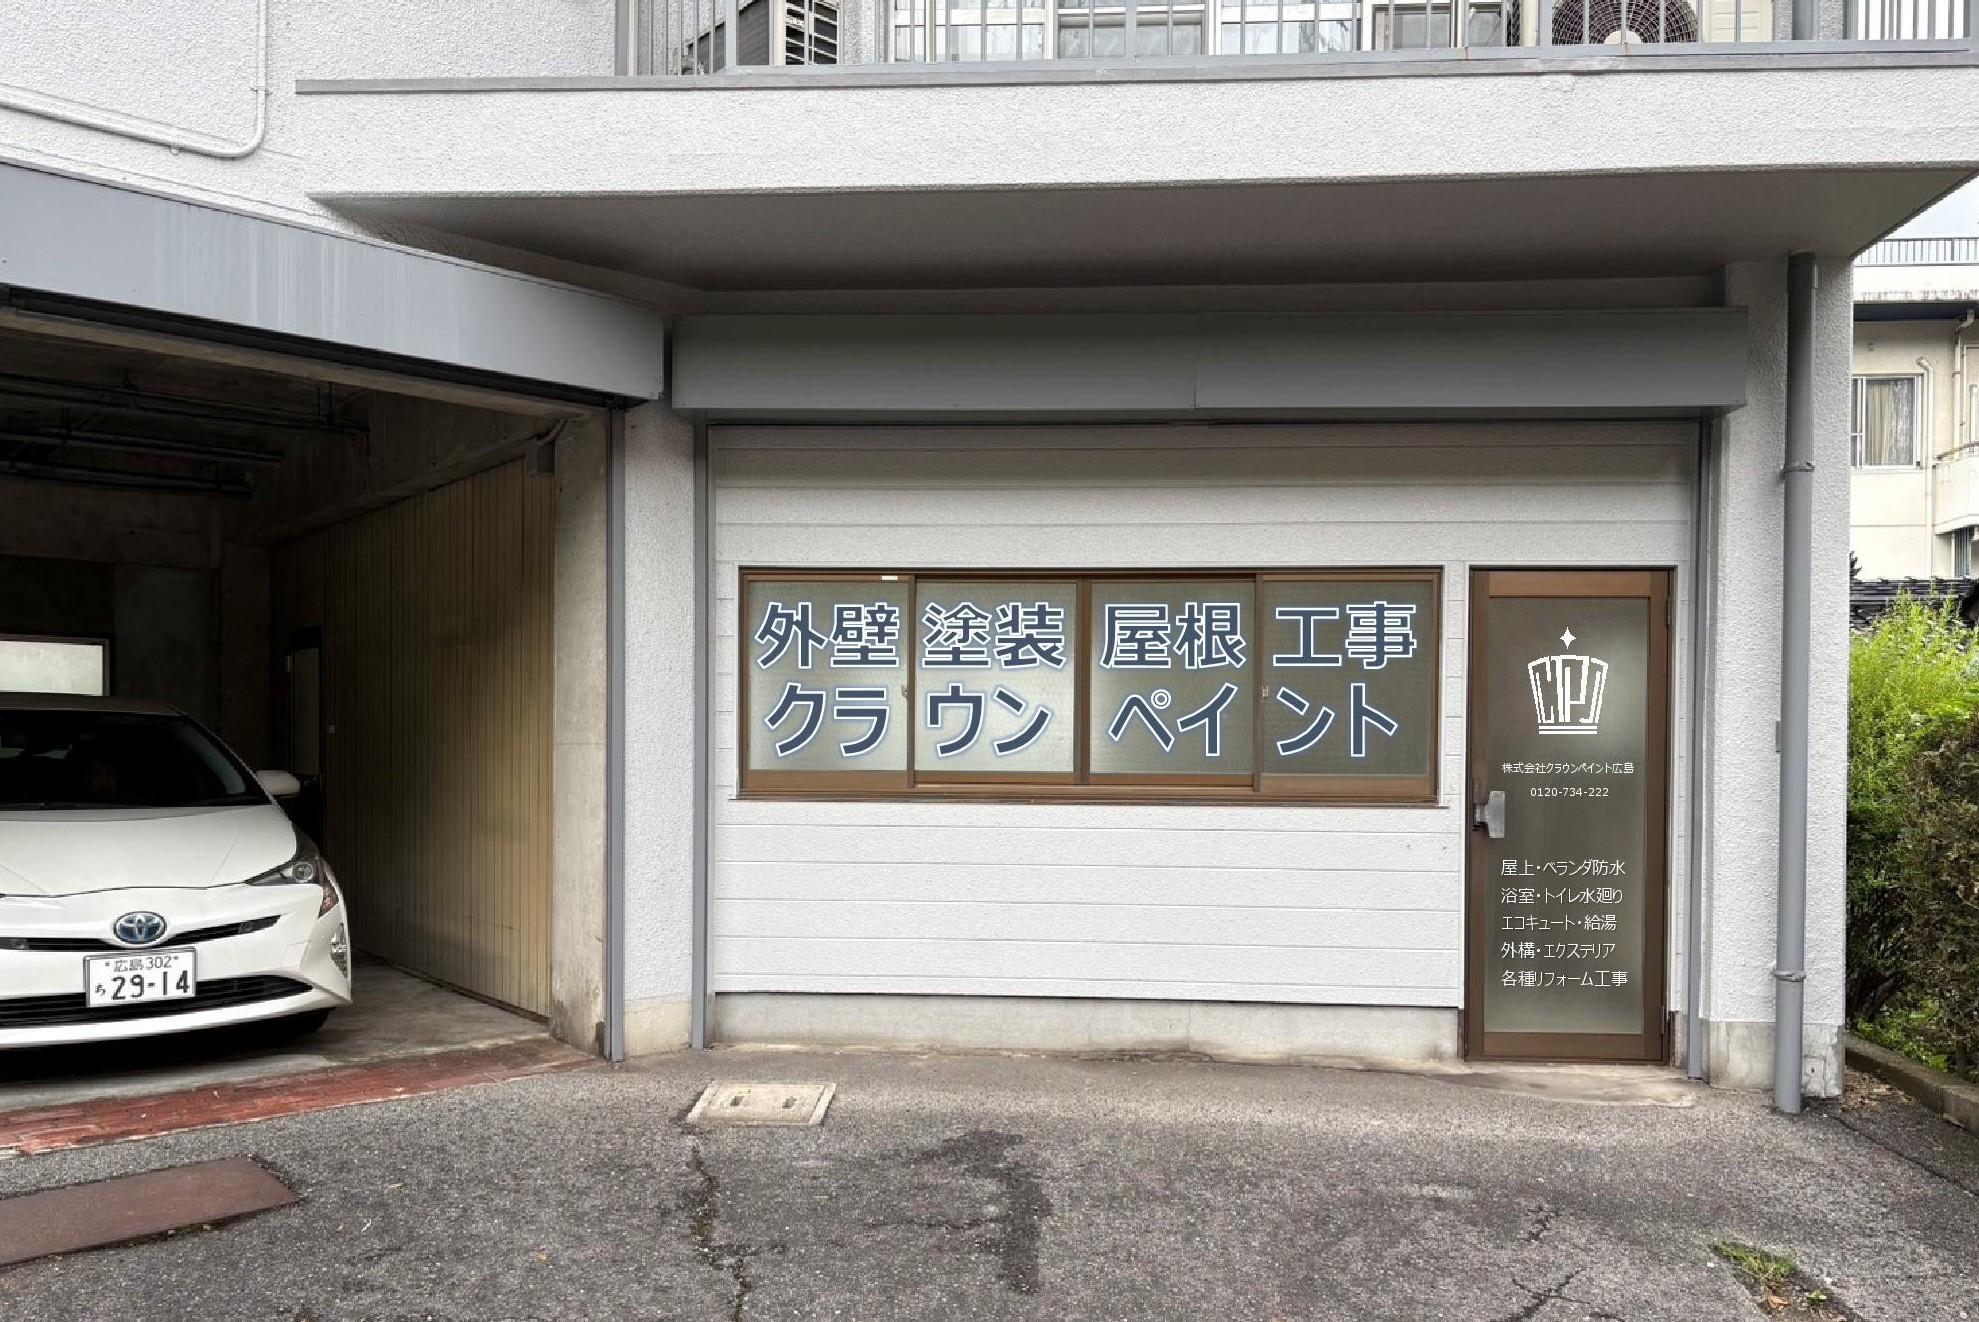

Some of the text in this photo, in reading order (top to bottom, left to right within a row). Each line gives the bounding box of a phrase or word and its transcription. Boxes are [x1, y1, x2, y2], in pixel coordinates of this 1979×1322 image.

[1502, 762, 1635, 774] 株式会社クラウンペイント広島
[1530, 787, 1609, 797] 0120-734-222
[111, 970, 190, 1000] 29-14
[1501, 970, 1628, 987] 各種リフォーム工事
